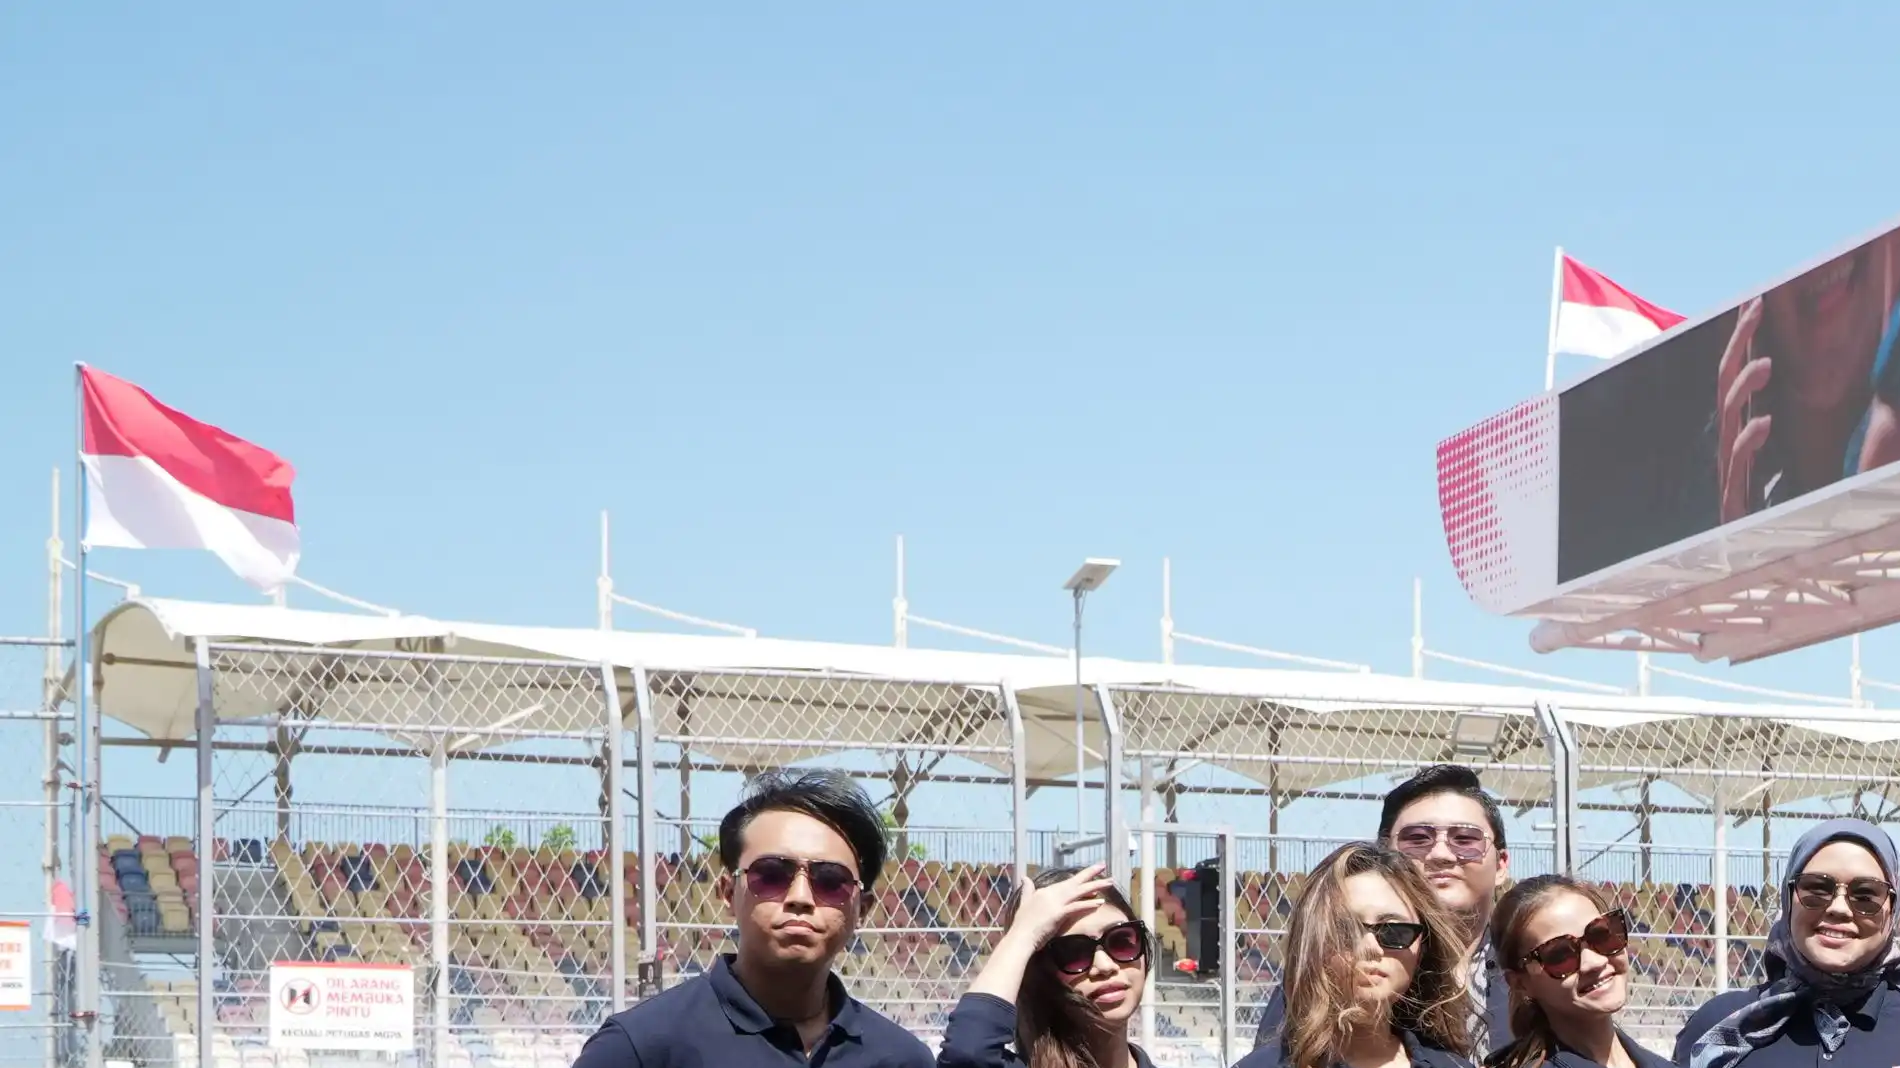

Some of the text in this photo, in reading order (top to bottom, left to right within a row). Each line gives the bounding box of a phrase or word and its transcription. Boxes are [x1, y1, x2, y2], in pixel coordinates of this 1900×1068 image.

[326, 978, 400, 990] DILARANG
[326, 991, 404, 1005] MEMBUKA
[326, 1005, 371, 1018] PINTU
